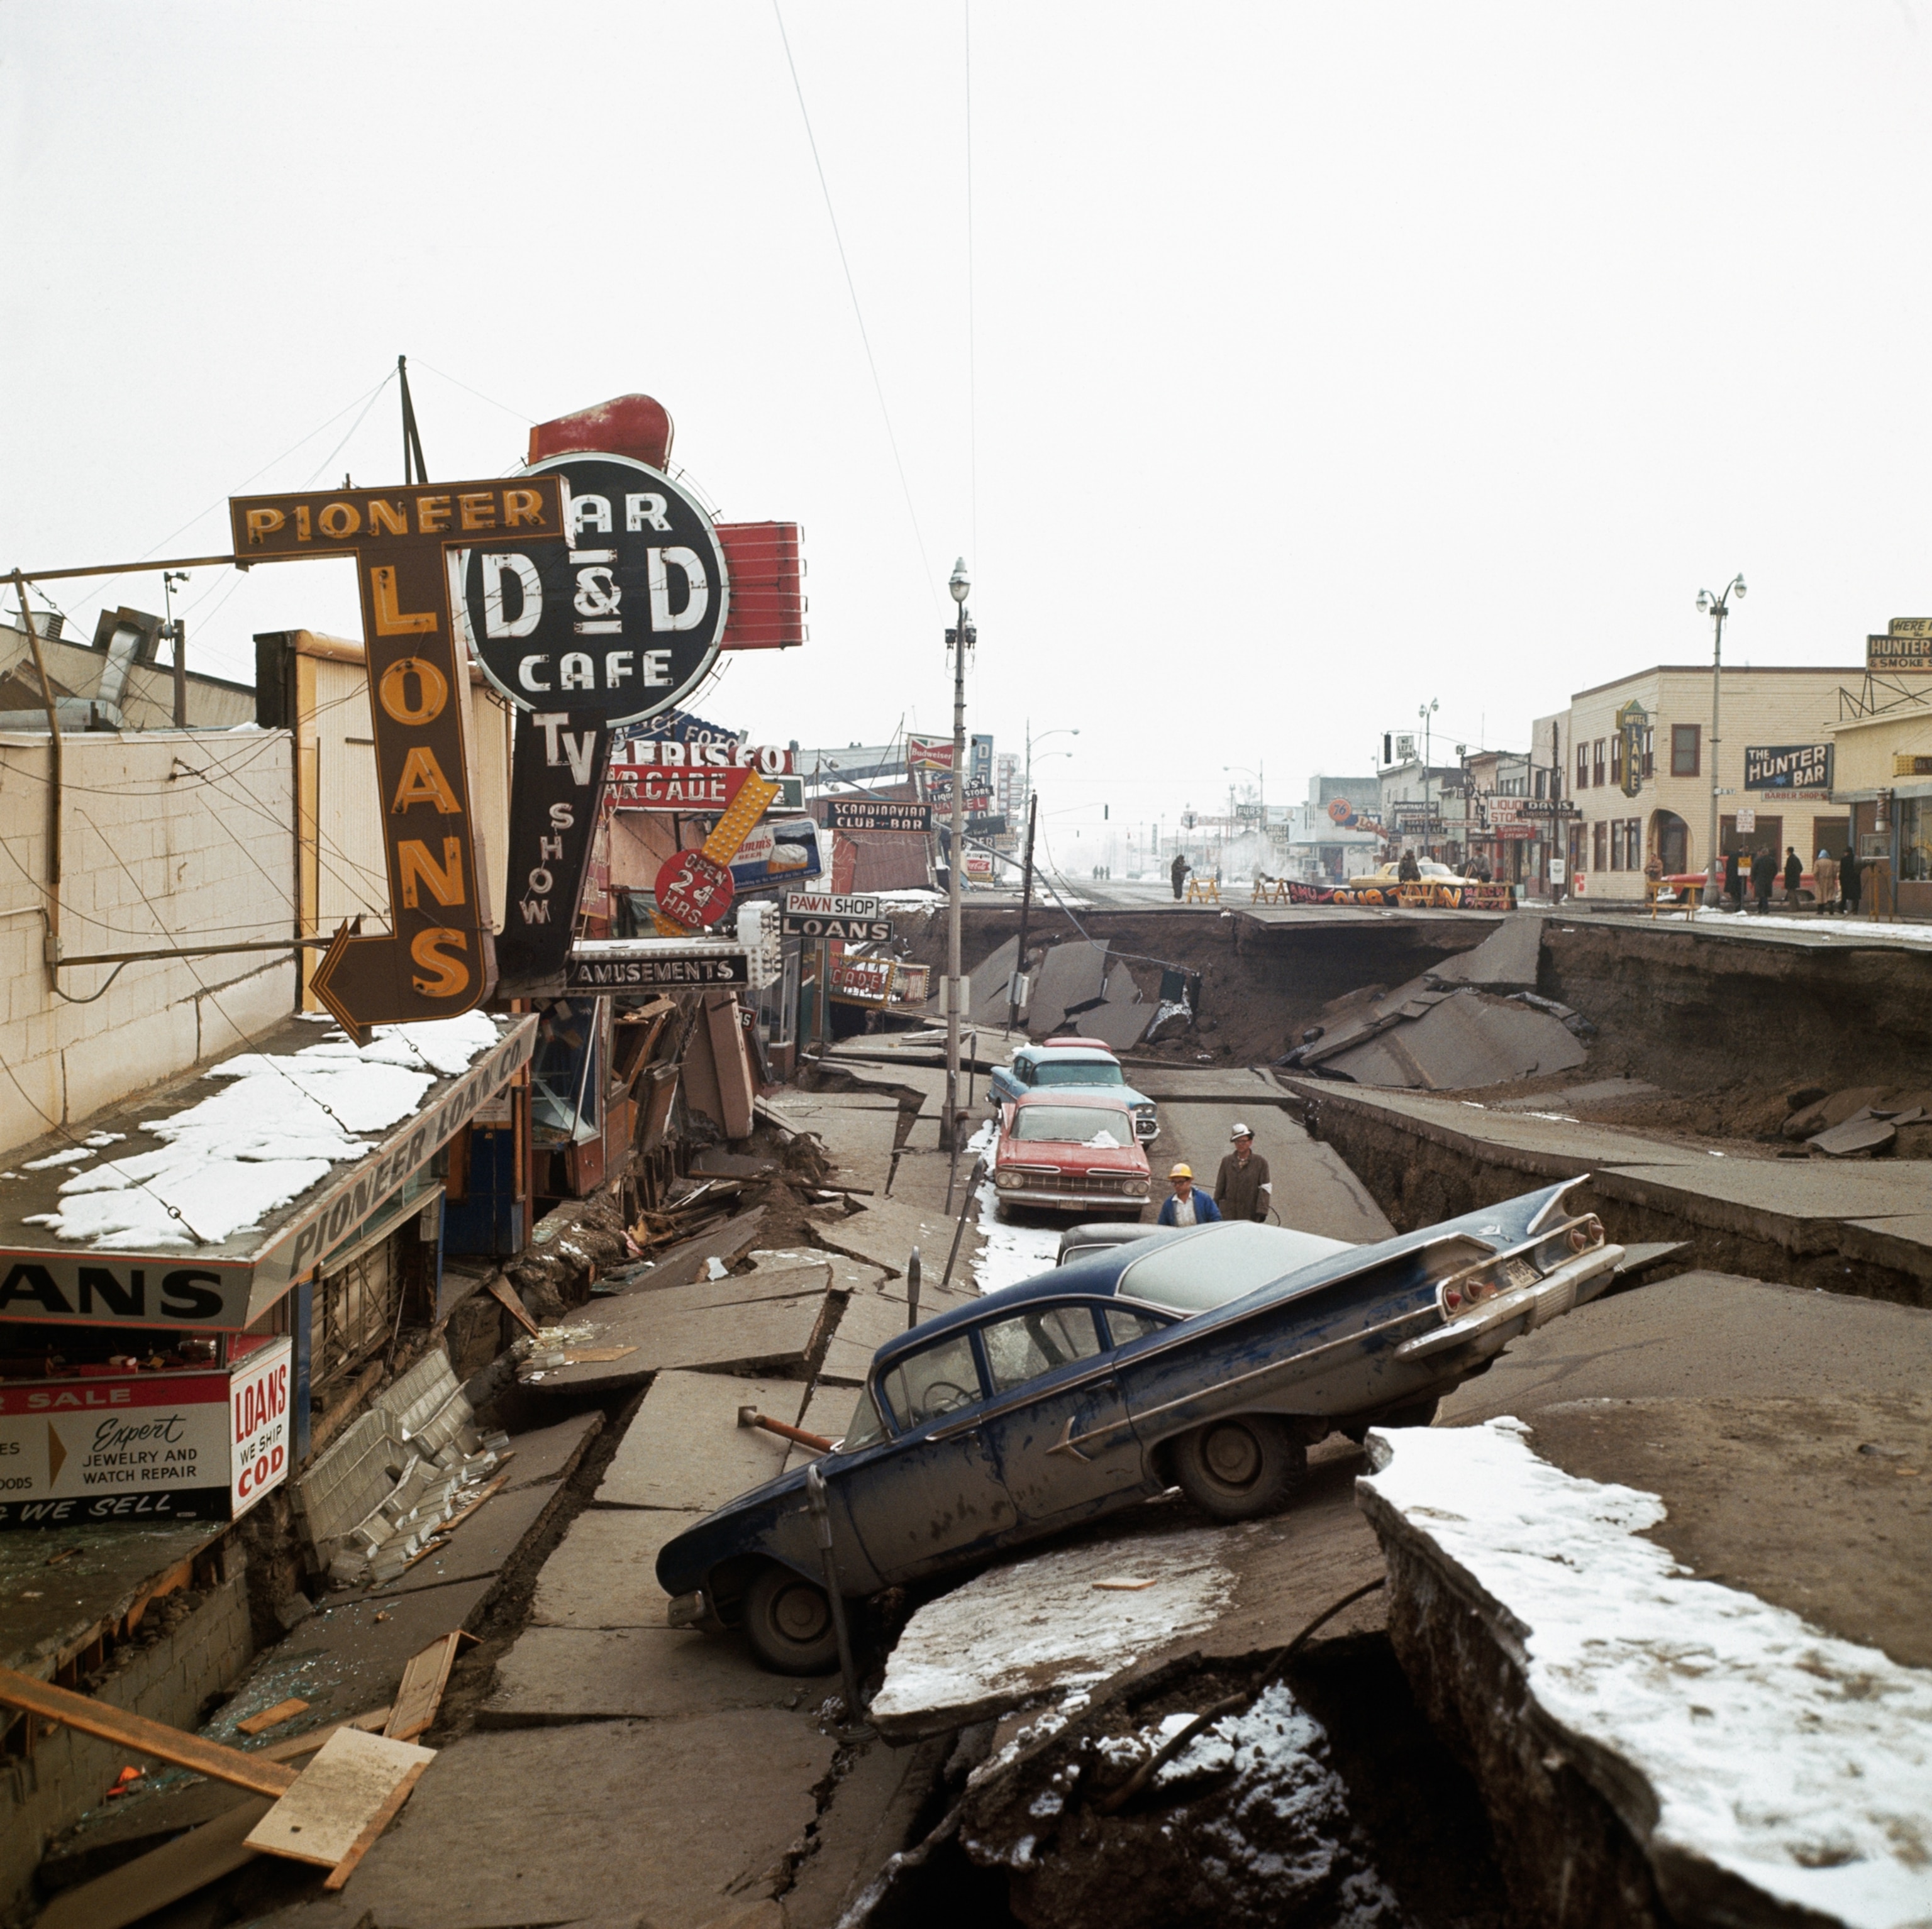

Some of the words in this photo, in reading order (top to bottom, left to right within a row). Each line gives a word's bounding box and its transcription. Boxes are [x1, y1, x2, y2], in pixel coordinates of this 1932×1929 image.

[246, 489, 546, 544] PIONEER
[570, 492, 672, 533] AR
[482, 553, 543, 639] D
[574, 567, 622, 617] &
[647, 546, 709, 632] D
[1894, 620, 1926, 631] HERE
[1870, 639, 1931, 655] HUNTER
[518, 649, 674, 692] CAFE
[1879, 658, 1923, 668] SMOKE
[533, 712, 597, 785] TV
[911, 747, 952, 760] Budweiser
[1748, 749, 1770, 761] THE
[1748, 745, 1826, 782] HUNTER
[370, 565, 470, 998] LOANS
[604, 770, 726, 802] ARCADE
[1793, 765, 1825, 787] BAR
[933, 792, 953, 802] LIQU
[964, 788, 990, 797] STORE
[1490, 799, 1524, 811] LIQUO
[1764, 791, 1797, 799] BARBER
[1799, 790, 1821, 799] SHOP
[834, 802, 926, 817] SCANDINAVIAN
[1237, 807, 1262, 815] FURS
[1333, 804, 1346, 815] 76
[1528, 802, 1571, 810] DAVIS
[836, 817, 875, 829] CLUB
[890, 818, 923, 830] BAR
[738, 836, 772, 854] amm's
[738, 850, 762, 861] BEER
[519, 803, 574, 924] SHOW
[684, 853, 727, 887] OPEN
[669, 869, 715, 908] 24
[789, 894, 832, 912] PAWN
[835, 898, 875, 915] SHOP
[782, 917, 889, 940] LOANS
[577, 959, 734, 984] AMUSEMENTS
[289, 1127, 426, 1281] PIONEER
[436, 1070, 492, 1144] LOAN
[499, 1039, 523, 1082] CO.
[0, 1263, 224, 1319] ANS
[27, 1388, 131, 1408] SALE
[235, 1363, 286, 1444] LOANS
[92, 1414, 186, 1452] Expert
[240, 1444, 256, 1466] WE
[258, 1424, 282, 1452] SHIP
[83, 1450, 158, 1467] JEWELRY
[165, 1448, 197, 1462] AND
[83, 1470, 135, 1484] WATCH
[141, 1466, 197, 1481] REPAIR
[238, 1444, 284, 1498] COD
[20, 1501, 77, 1522] WE
[89, 1494, 171, 1517] SELL
